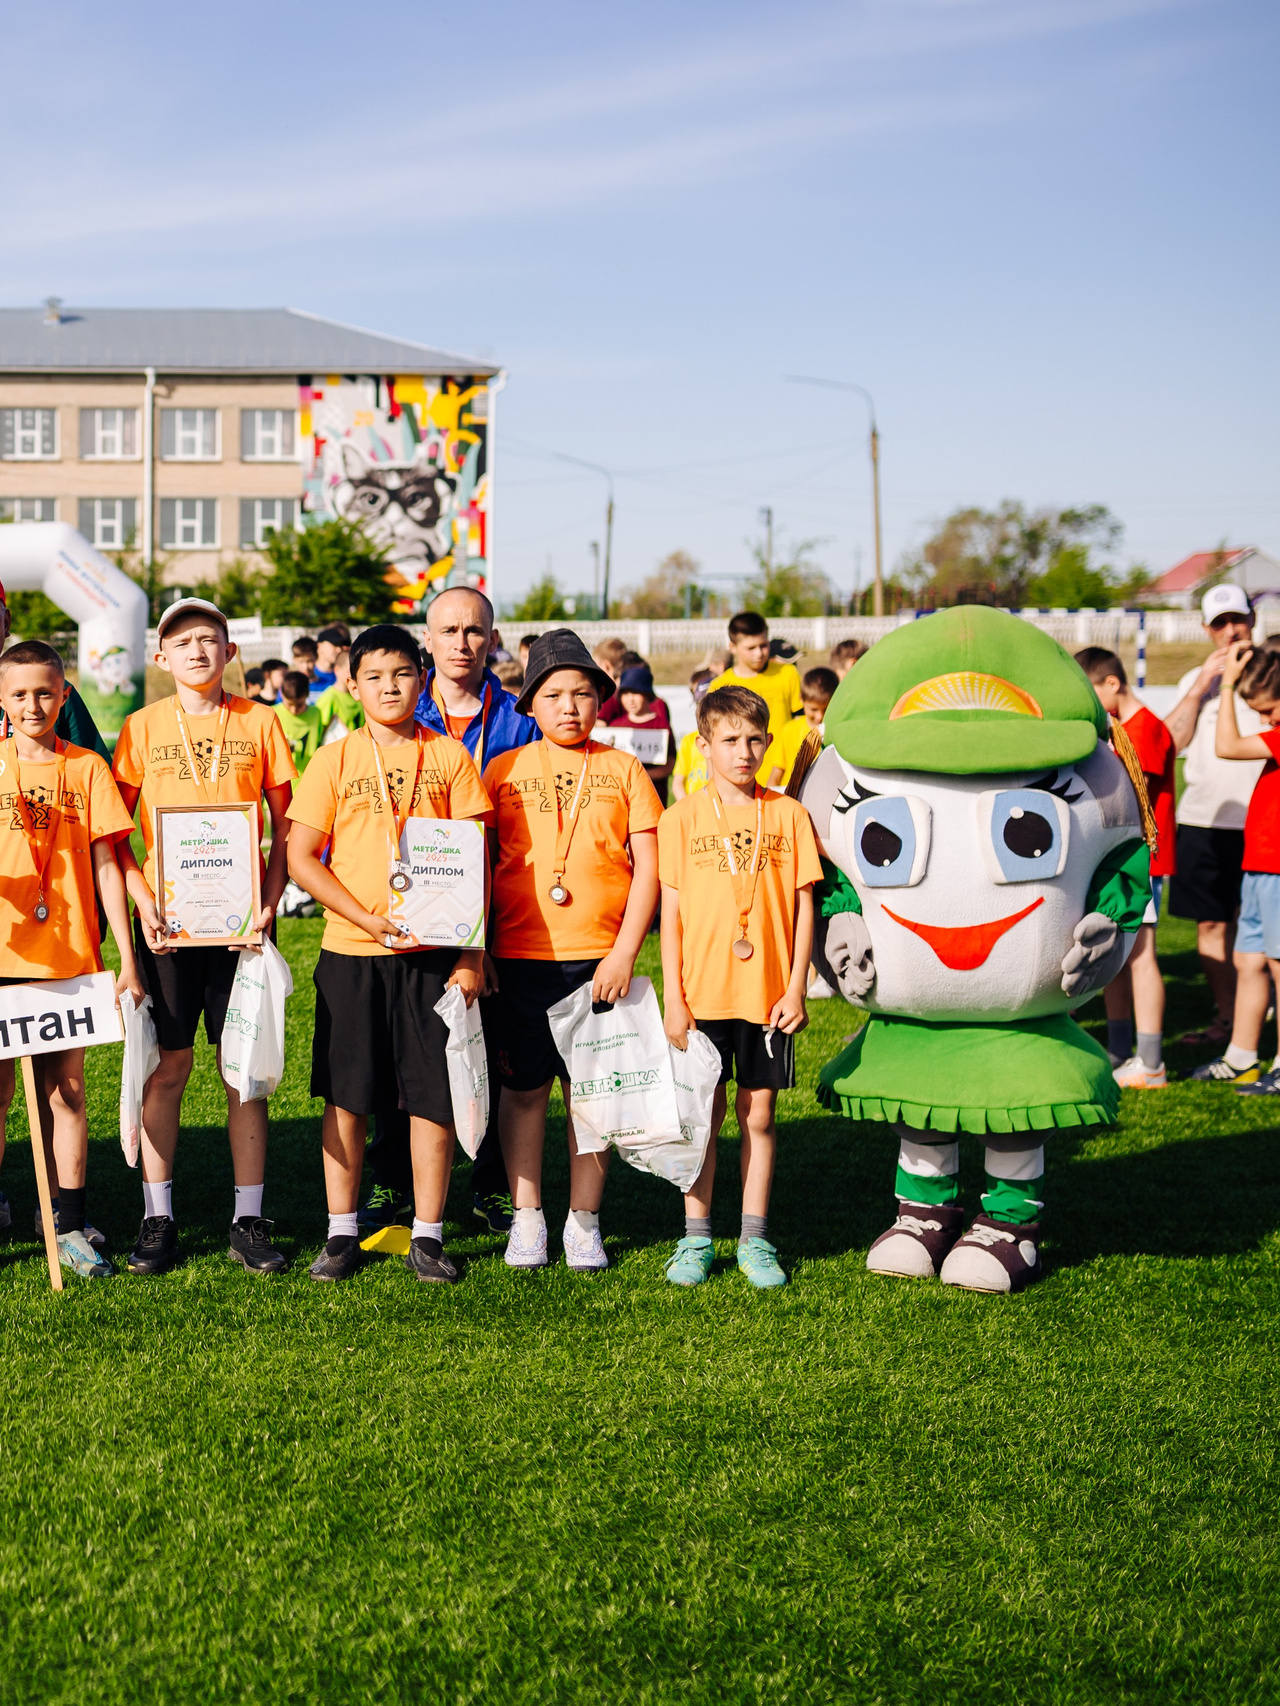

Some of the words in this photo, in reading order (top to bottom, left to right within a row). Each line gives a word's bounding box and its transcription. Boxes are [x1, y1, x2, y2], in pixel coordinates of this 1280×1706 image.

[193, 845, 216, 855] 2025
[425, 853, 448, 862] 2025
[180, 858, 233, 869] ДИПЛОМ
[411, 865, 464, 876] ДИПЛОМ
[570, 1069, 662, 1098] МЕТРОШКА
